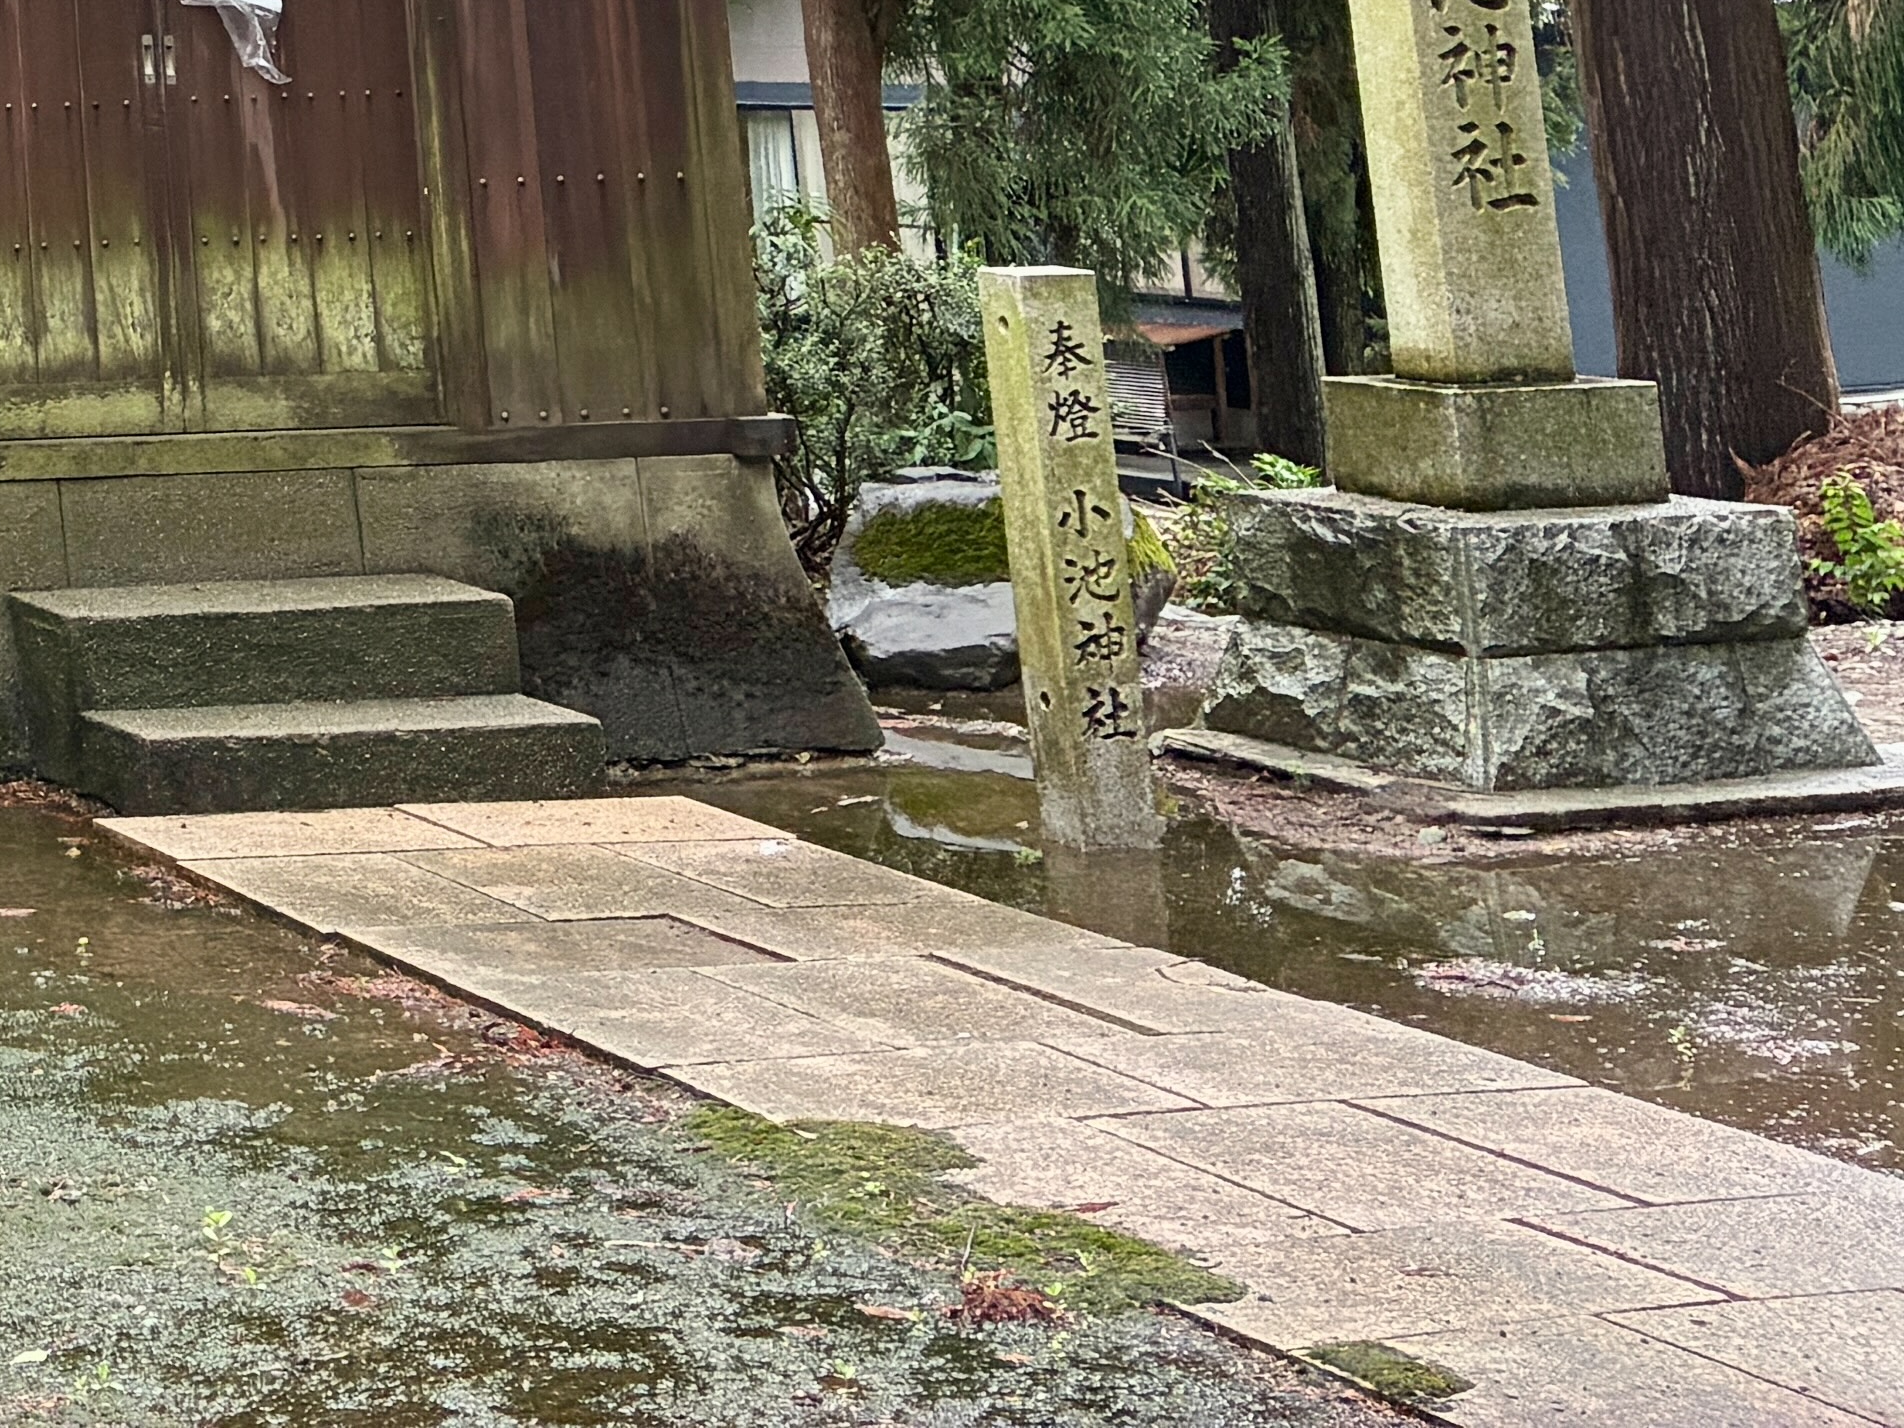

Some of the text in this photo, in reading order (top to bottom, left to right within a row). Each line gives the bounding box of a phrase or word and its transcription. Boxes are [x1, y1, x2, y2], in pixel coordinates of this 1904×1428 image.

[1043, 320, 1137, 741] 奉燈 小池神社
